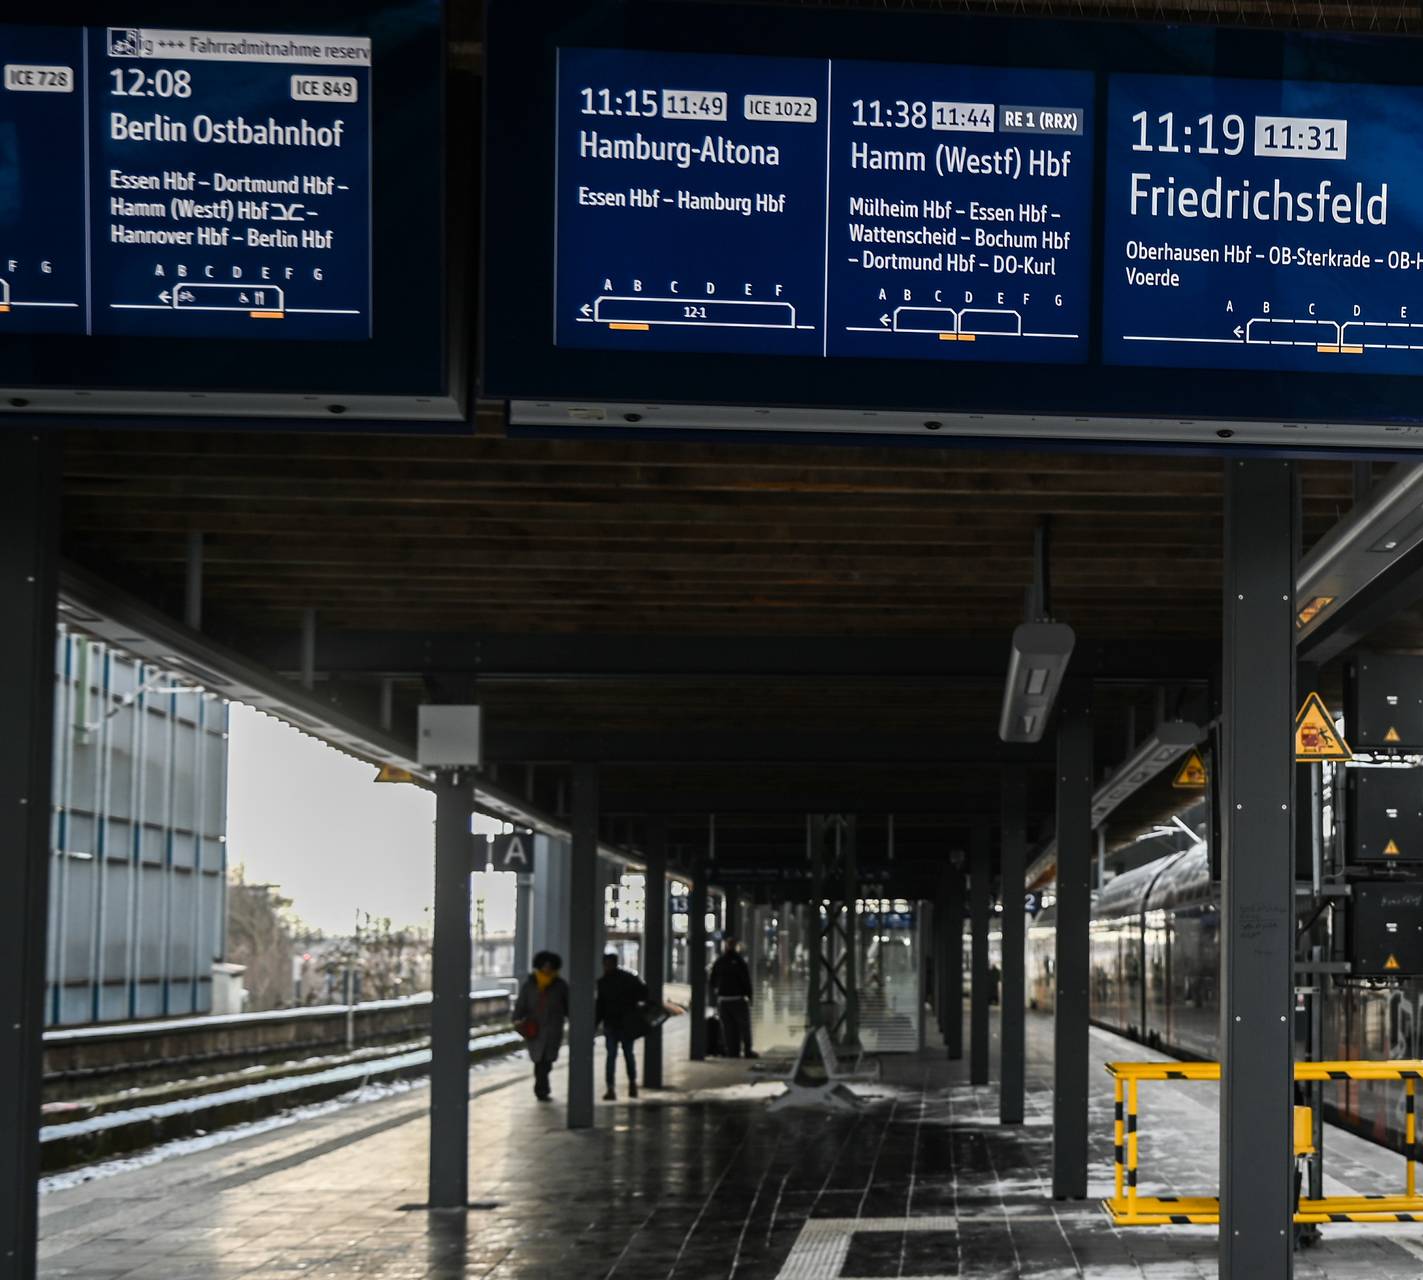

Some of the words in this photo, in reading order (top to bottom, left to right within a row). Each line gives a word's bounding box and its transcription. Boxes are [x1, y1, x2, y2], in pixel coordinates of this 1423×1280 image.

[189, 35, 322, 58] Fahrradmitnahme
[323, 42, 369, 60] reserv
[10, 70, 34, 86] ICE
[37, 70, 68, 87] 728
[110, 68, 192, 99] 12:08
[296, 80, 320, 96] ICE
[322, 81, 353, 97] 849
[580, 87, 658, 118] 11:15
[667, 95, 723, 116] 11:49
[750, 100, 771, 115] ICE
[775, 101, 812, 117] 1022
[852, 99, 927, 129] 11:38
[936, 107, 991, 128] 11:44
[110, 112, 187, 143] Berlin
[192, 114, 345, 147] Ostbahnhof
[1005, 110, 1023, 127] RE
[1026, 111, 1035, 128] 1
[1039, 111, 1078, 132] (RRX)
[1132, 110, 1245, 156] 11:19
[1264, 124, 1339, 152] 11:31
[580, 130, 780, 169] Hamburg-Altona
[851, 141, 926, 172] Hamm
[935, 143, 1022, 180] (Westf)
[1029, 149, 1072, 177] Hbf
[109, 169, 161, 190] Essen
[163, 171, 197, 191] Hbf
[213, 172, 300, 194] Dortmund
[302, 175, 335, 195] Hbf
[110, 196, 166, 217] Hamm
[170, 197, 234, 223] (Westf)
[237, 200, 270, 220] Hbf
[578, 186, 626, 207] Essen
[629, 188, 661, 209] Hbf
[677, 190, 752, 216] Hamburg
[755, 193, 786, 213] Hbf
[849, 196, 919, 218] Mülheim
[923, 199, 953, 220] Hbf
[969, 201, 1015, 222] Essen
[1018, 203, 1048, 223] Hbf
[1130, 172, 1388, 225] Friedrichsfeld
[110, 223, 195, 245] Hannover
[197, 226, 230, 246] Hbf
[247, 227, 299, 248] Berlin
[301, 229, 334, 249] Hbf
[848, 223, 957, 246] Wattenscheid
[975, 227, 1038, 249] Bochum
[1041, 230, 1071, 250] Hbf
[8, 259, 18, 273] F
[40, 260, 52, 274] G
[862, 249, 943, 272] Dortmund
[946, 253, 977, 273] Hbf
[993, 254, 1056, 276] DO-Kurl
[1126, 240, 1220, 263] Oberhausen
[1224, 244, 1253, 264] Hbf
[1268, 245, 1371, 268] OB-Sterkrade
[154, 263, 165, 277] A
[177, 264, 188, 278] B
[204, 264, 214, 278] C
[232, 265, 243, 279] D
[261, 266, 270, 280] E
[284, 267, 294, 280] F
[313, 267, 323, 281] G
[1125, 266, 1180, 287] Voerde
[603, 278, 613, 291] A
[633, 279, 642, 292] B
[670, 280, 679, 294] C
[706, 281, 715, 295] D
[744, 283, 753, 296] E
[775, 284, 783, 297] F
[878, 287, 887, 301] A
[903, 288, 912, 301] B
[934, 289, 942, 303] C
[964, 290, 973, 304] D
[997, 292, 1005, 305] E
[1023, 292, 1030, 305] F
[1054, 294, 1063, 307] G
[683, 306, 707, 319] 12-1
[1226, 299, 1234, 313] A
[1263, 301, 1270, 314] B
[1308, 302, 1316, 315] C
[1353, 304, 1361, 317] D
[1400, 306, 1407, 319] E
[504, 835, 528, 864] A
